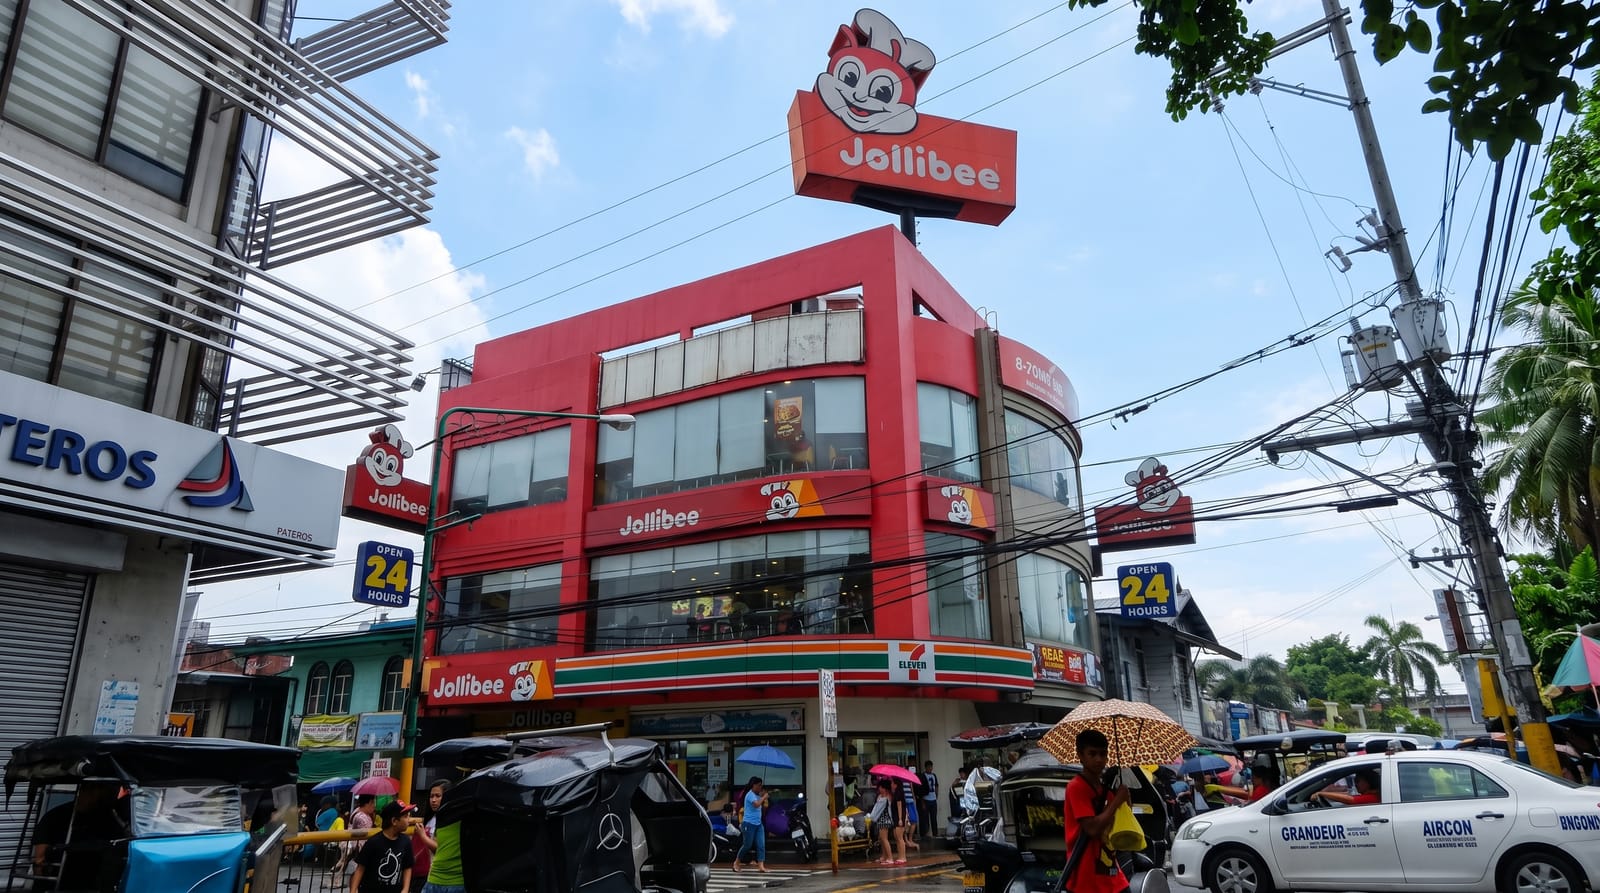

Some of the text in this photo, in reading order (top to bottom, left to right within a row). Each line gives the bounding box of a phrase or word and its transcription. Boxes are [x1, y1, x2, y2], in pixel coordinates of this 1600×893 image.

[839, 137, 1000, 190] Jollibee
[368, 489, 427, 516] Jollibee
[620, 508, 699, 536] Jollibee
[277, 527, 313, 542] PATEROS
[377, 545, 403, 558] OPEN
[365, 555, 408, 593] 24
[1129, 565, 1158, 575] OPEN
[368, 590, 403, 604] HOURS
[1121, 573, 1170, 605] 24
[1128, 606, 1168, 617] HOURS
[433, 673, 505, 698] Jollibee
[1281, 824, 1346, 841] GRANDEUR
[1424, 820, 1473, 836] AIRCON
